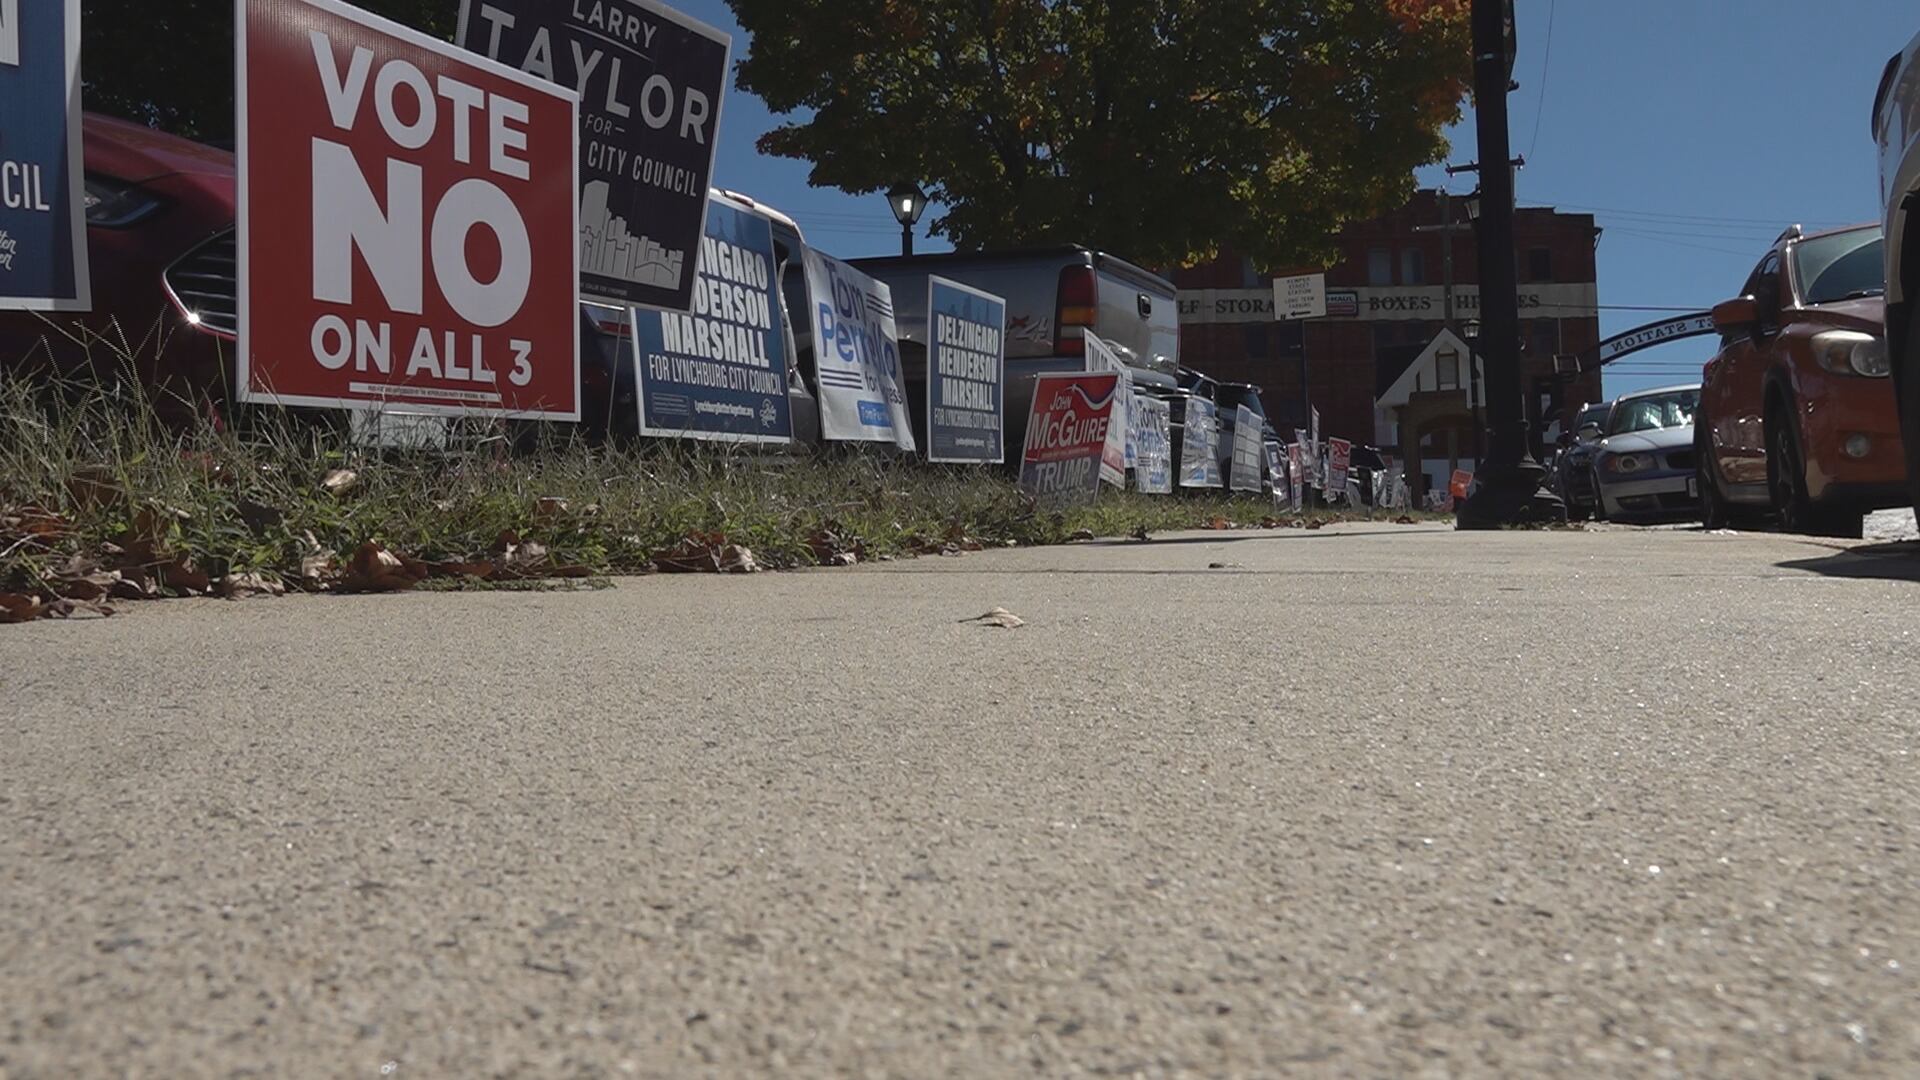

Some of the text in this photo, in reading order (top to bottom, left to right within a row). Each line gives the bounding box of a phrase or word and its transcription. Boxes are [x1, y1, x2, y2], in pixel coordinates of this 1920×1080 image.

[572, 0, 657, 48] LARRY
[481, 3, 709, 145] TAYLOR
[310, 29, 530, 181] VOTE
[585, 113, 612, 136] FOR
[587, 140, 697, 197] CITY COUNCIL
[311, 136, 532, 327] NO
[824, 258, 866, 325] Tom
[1369, 295, 1431, 311] BOXES
[311, 314, 532, 386] ON ALL 3
[661, 311, 769, 368] MARSHALL
[937, 313, 999, 356] DELZINGARO
[649, 354, 783, 396] FOR LYNCHBURG CITY COUNCIL
[938, 345, 997, 384] HENDERSON
[942, 377, 994, 412] MARSHALL
[1035, 456, 1091, 493] TRUMP
